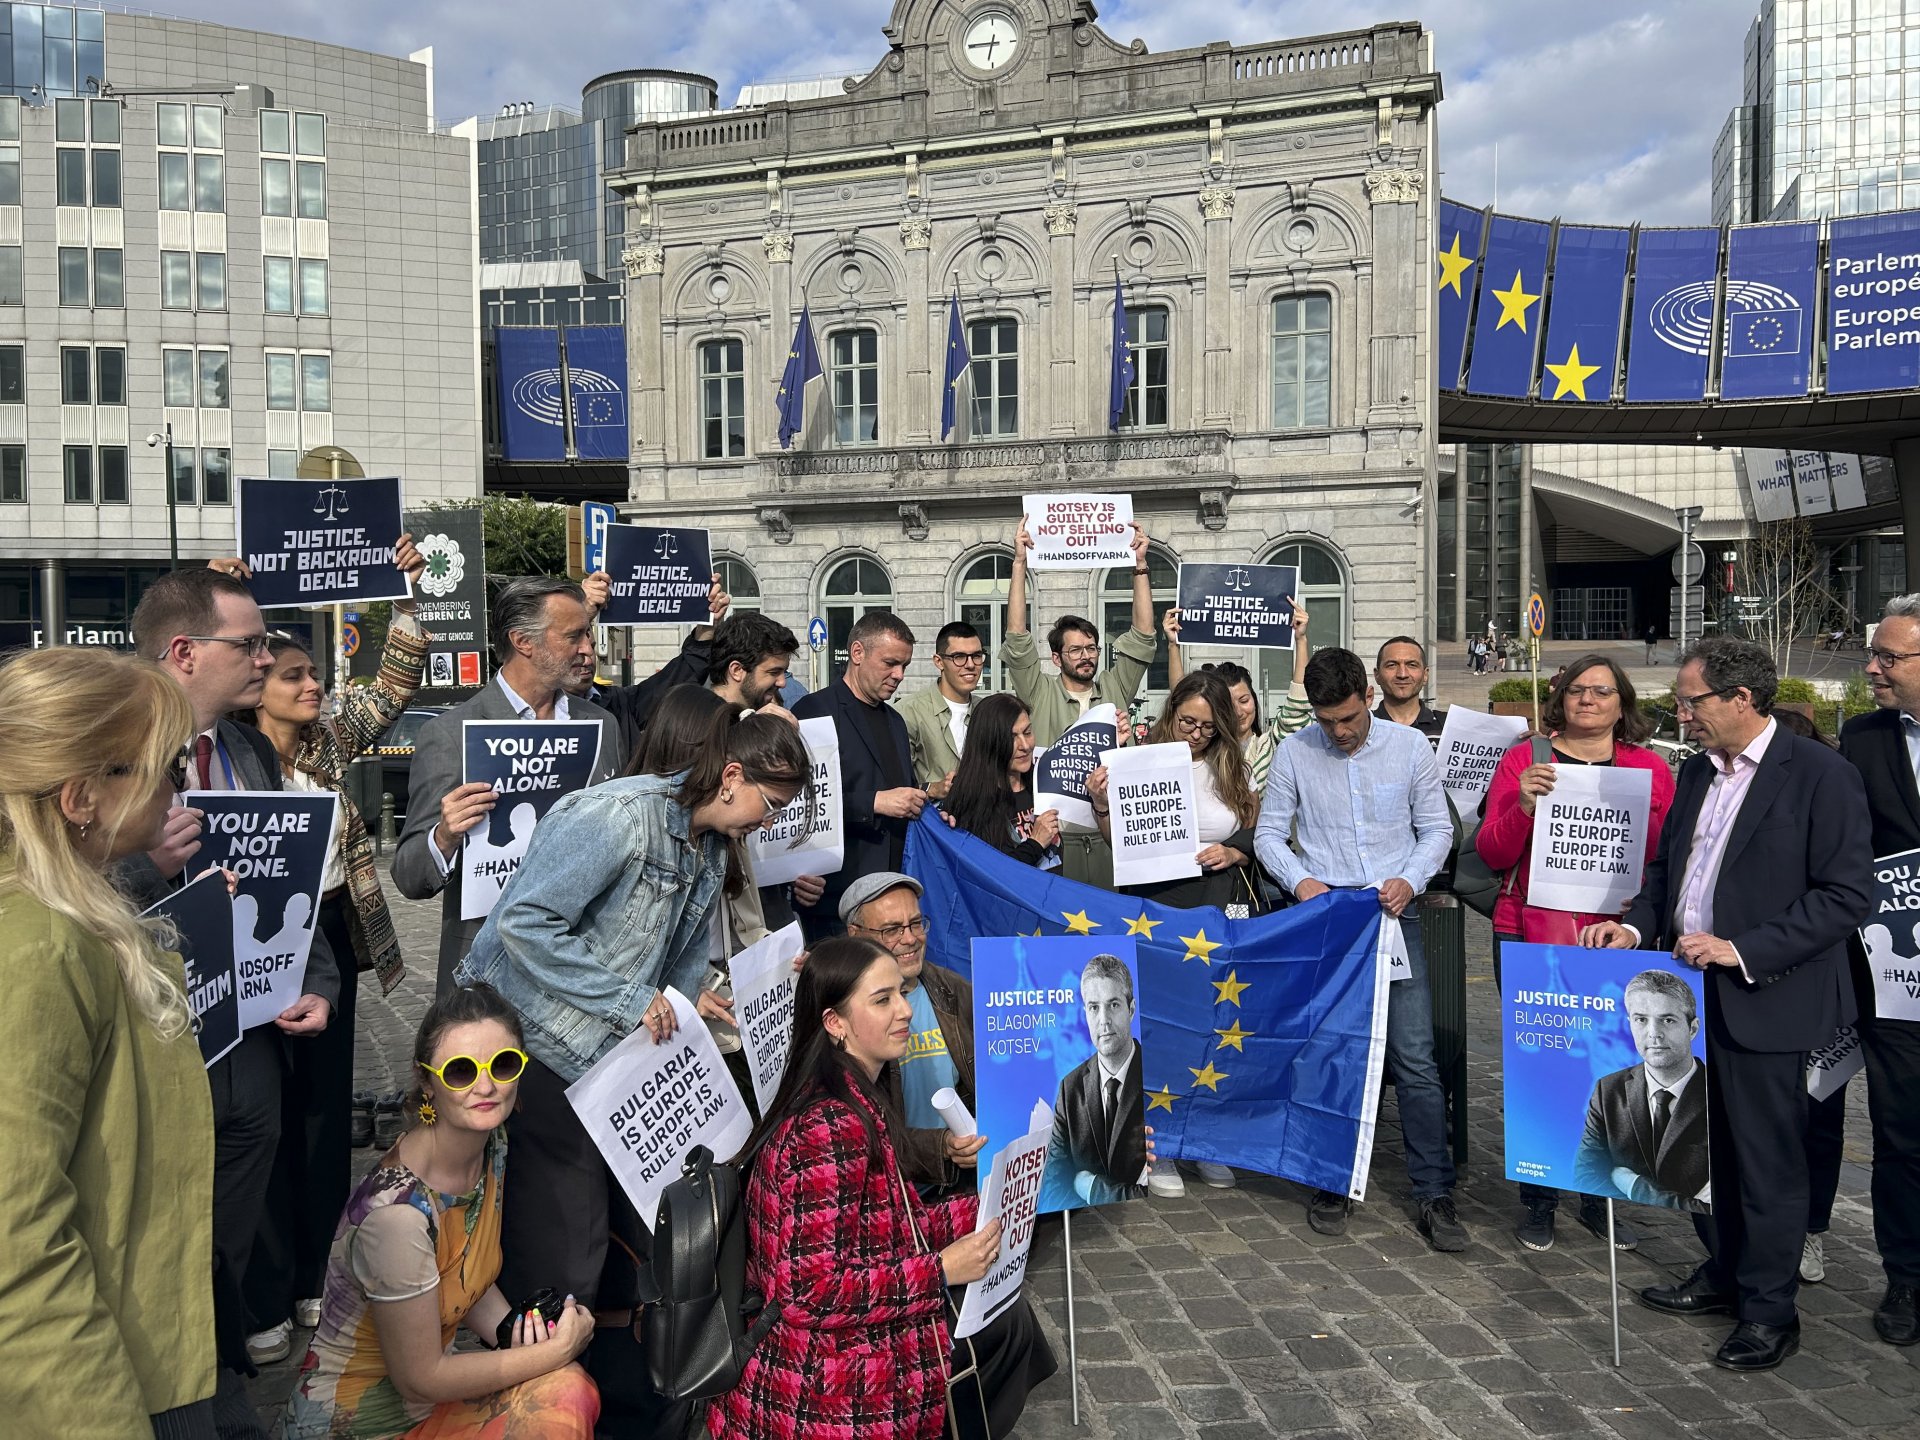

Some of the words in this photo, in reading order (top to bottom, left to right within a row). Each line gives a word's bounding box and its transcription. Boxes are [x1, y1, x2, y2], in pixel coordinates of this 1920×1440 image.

[1836, 253, 1920, 276] Parlem
[1835, 272, 1920, 298] europé
[1835, 306, 1920, 328] Europe
[1835, 329, 1920, 351] Parlem
[1775, 452, 1816, 472] INVEST
[1757, 474, 1791, 491] WHAT
[1798, 462, 1849, 484] MATTERS
[1046, 513, 1093, 523] GUILTY
[1097, 512, 1115, 522] OF
[1047, 503, 1098, 513] KOTSEV
[1102, 502, 1116, 512] IS
[591, 508, 609, 545] P
[1038, 525, 1066, 535] NOT
[1069, 524, 1125, 534] SELLING
[283, 527, 371, 549] JUSTICE,
[1066, 536, 1097, 546] OUT!
[249, 553, 290, 572] NOT
[297, 546, 397, 570] BACKROOM
[1037, 551, 1130, 560] #HANDSOFFVARNA
[299, 570, 359, 592] DEALS
[631, 565, 692, 582] JUSTICE,
[608, 582, 636, 597] NOT
[639, 582, 711, 597] BACKROOM
[638, 600, 682, 614] DEALS
[1204, 595, 1269, 612] JUSTICE,
[1182, 609, 1209, 622] NOT
[1214, 610, 1290, 626] BACKROOM
[448, 632, 474, 641] GENOCIDE
[1214, 624, 1259, 638] DEALS
[485, 738, 534, 756] YOU
[538, 738, 579, 755] ARE
[1061, 745, 1096, 758] SEES.
[512, 757, 556, 775] NOT
[1447, 755, 1460, 767] IS
[491, 774, 562, 794] ALONE.
[1049, 769, 1084, 782] WON'T
[1447, 769, 1491, 783] EUROPE
[1118, 780, 1182, 800] BULGARIA
[1441, 780, 1464, 790] RULE
[1466, 782, 1480, 792] OF
[1120, 803, 1133, 817] IS
[1135, 798, 1187, 815] EUROPE.
[1551, 804, 1631, 825] BULGARIA
[206, 813, 259, 834] YOU
[262, 813, 311, 833] ARE
[760, 826, 787, 843] RULE
[790, 824, 804, 837] OF
[810, 819, 833, 834] AW.
[1126, 816, 1168, 832] EUROPE
[1170, 814, 1182, 827] IS
[1549, 822, 1564, 837] IS
[1568, 824, 1633, 843] EUROPE.
[228, 836, 283, 857] NOT
[1124, 833, 1148, 847] RULE
[1150, 832, 1162, 844] OF
[1164, 829, 1189, 841] LAW.
[1552, 841, 1607, 858] EUROPE
[1611, 846, 1625, 859] IS
[473, 856, 525, 878] #HAN
[1545, 856, 1577, 870] RULE
[1580, 859, 1597, 871] OF
[1600, 861, 1630, 875] LAW.
[1874, 865, 1911, 883] OU
[744, 977, 793, 1025] BULGARIA
[985, 990, 1044, 1008] JUSTICE
[1048, 989, 1074, 1005] FOR
[1514, 990, 1579, 1009] JUSTICE
[1583, 995, 1616, 1012] FOR
[987, 1012, 1056, 1032] BLAGOMIR
[1515, 1010, 1592, 1031] BLAGOMIR
[749, 1026, 760, 1049] IS
[987, 1037, 1041, 1056] KOTSEV
[1515, 1031, 1574, 1050] KOTSEV
[757, 1029, 787, 1068] EUROPE
[1817, 1036, 1860, 1071] VARNA
[759, 1062, 775, 1088] RULE
[774, 1053, 783, 1072] OF
[609, 1045, 697, 1132] BULGARIA
[620, 1126, 641, 1151] IS
[640, 1061, 711, 1131] EUROPE.
[635, 1098, 696, 1164] EUROPE
[694, 1083, 712, 1105] IS
[640, 1143, 677, 1183] RULE
[675, 1123, 693, 1147] OF
[694, 1093, 728, 1128] LAW.
[1515, 1166, 1547, 1178] europe.
[1518, 1161, 1543, 1170] renew
[1001, 1169, 1042, 1209] GUILTY
